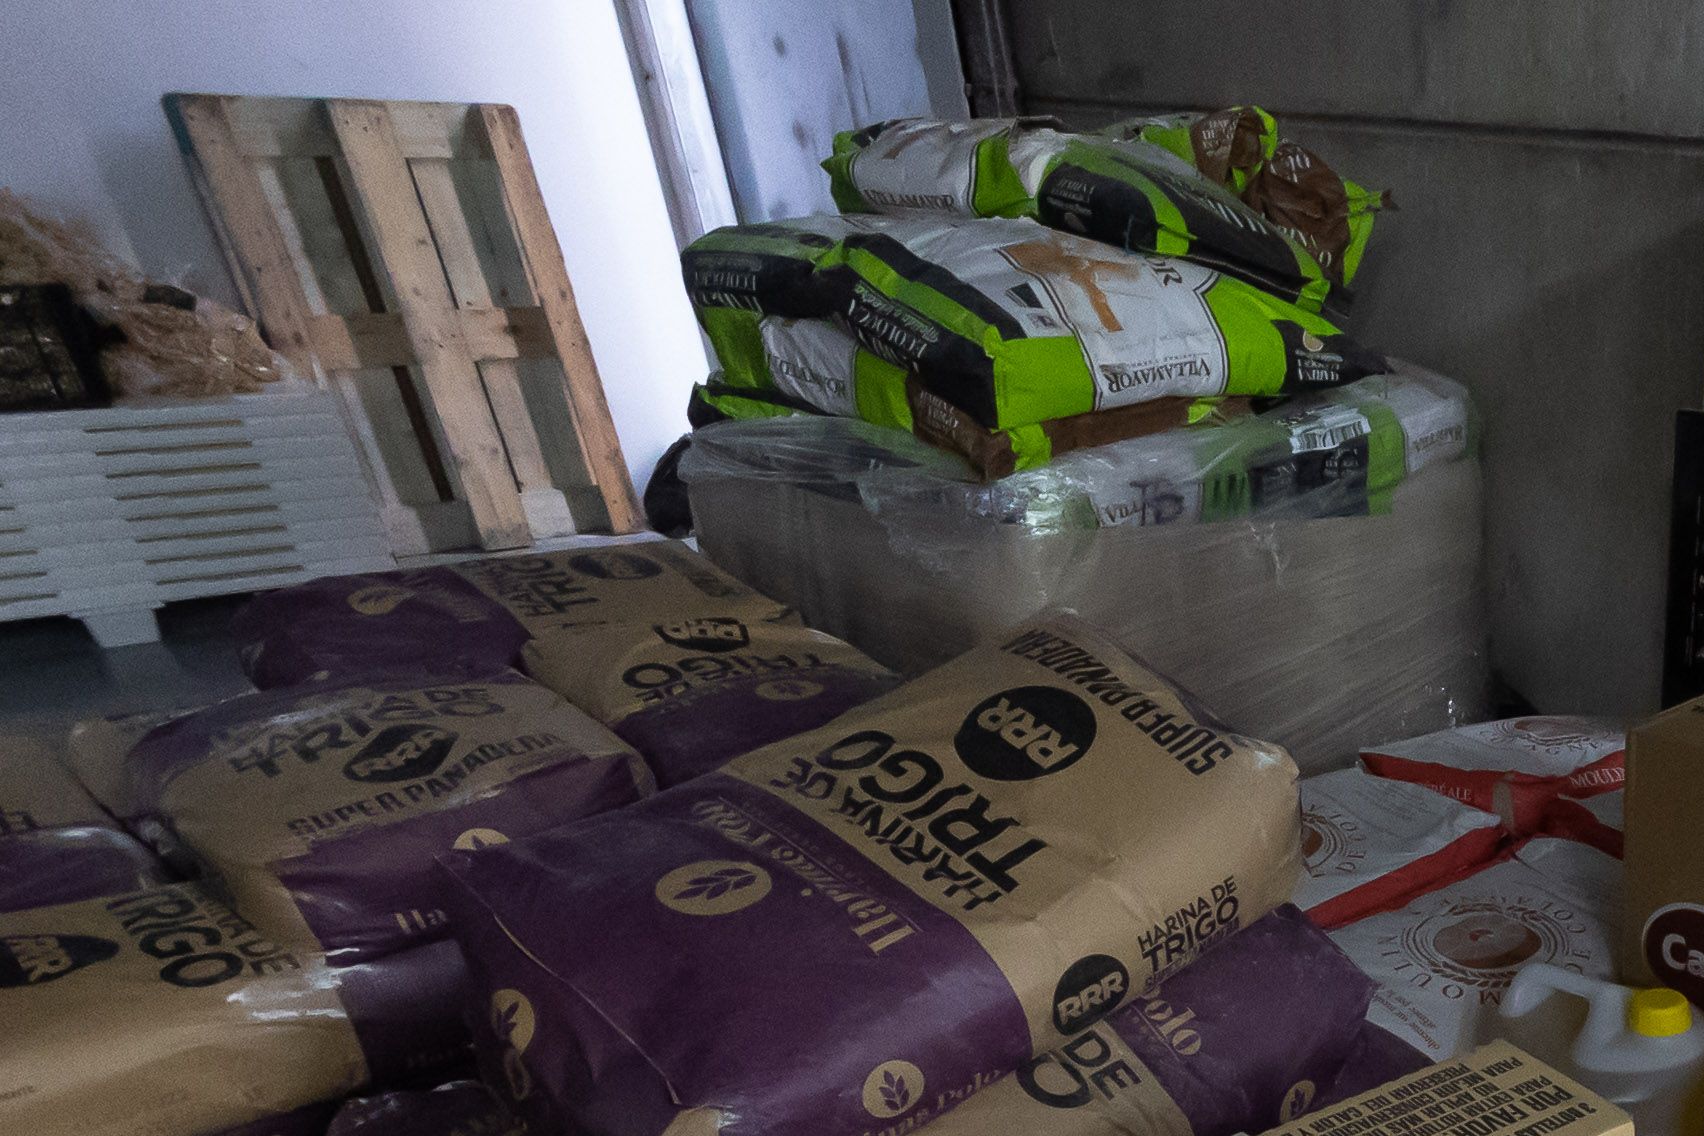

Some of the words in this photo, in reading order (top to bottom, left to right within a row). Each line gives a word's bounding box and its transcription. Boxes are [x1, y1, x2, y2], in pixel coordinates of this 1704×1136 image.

[1108, 358, 1211, 393] VILLAMAYOR
[976, 696, 1080, 770] RRR
[770, 756, 837, 799] DE
[815, 730, 1049, 892] TRIGO
[830, 787, 1003, 910] HARINA
[1137, 897, 1210, 948] HARINA
[1211, 876, 1238, 903] DE
[1142, 895, 1240, 972] TRIGO
[1057, 970, 1124, 1028] RRR
[1064, 1029, 1142, 1102] DE
[1483, 1056, 1522, 1079] PARA
[1389, 1061, 1470, 1104] PRESERVAR
[1434, 1071, 1484, 1098] MEJOR
[1474, 1082, 1498, 1098] NO
[1514, 1075, 1552, 1096] PARA
[1361, 1094, 1387, 1112] DEL
[1426, 1093, 1473, 1118] APILAR
[1466, 1091, 1512, 1117] EVITAR
[1528, 1085, 1572, 1111] POR
[1584, 1102, 1595, 1114] 3
[1310, 1107, 1357, 1133] CALOR
[1386, 1112, 1419, 1133] MÁS
